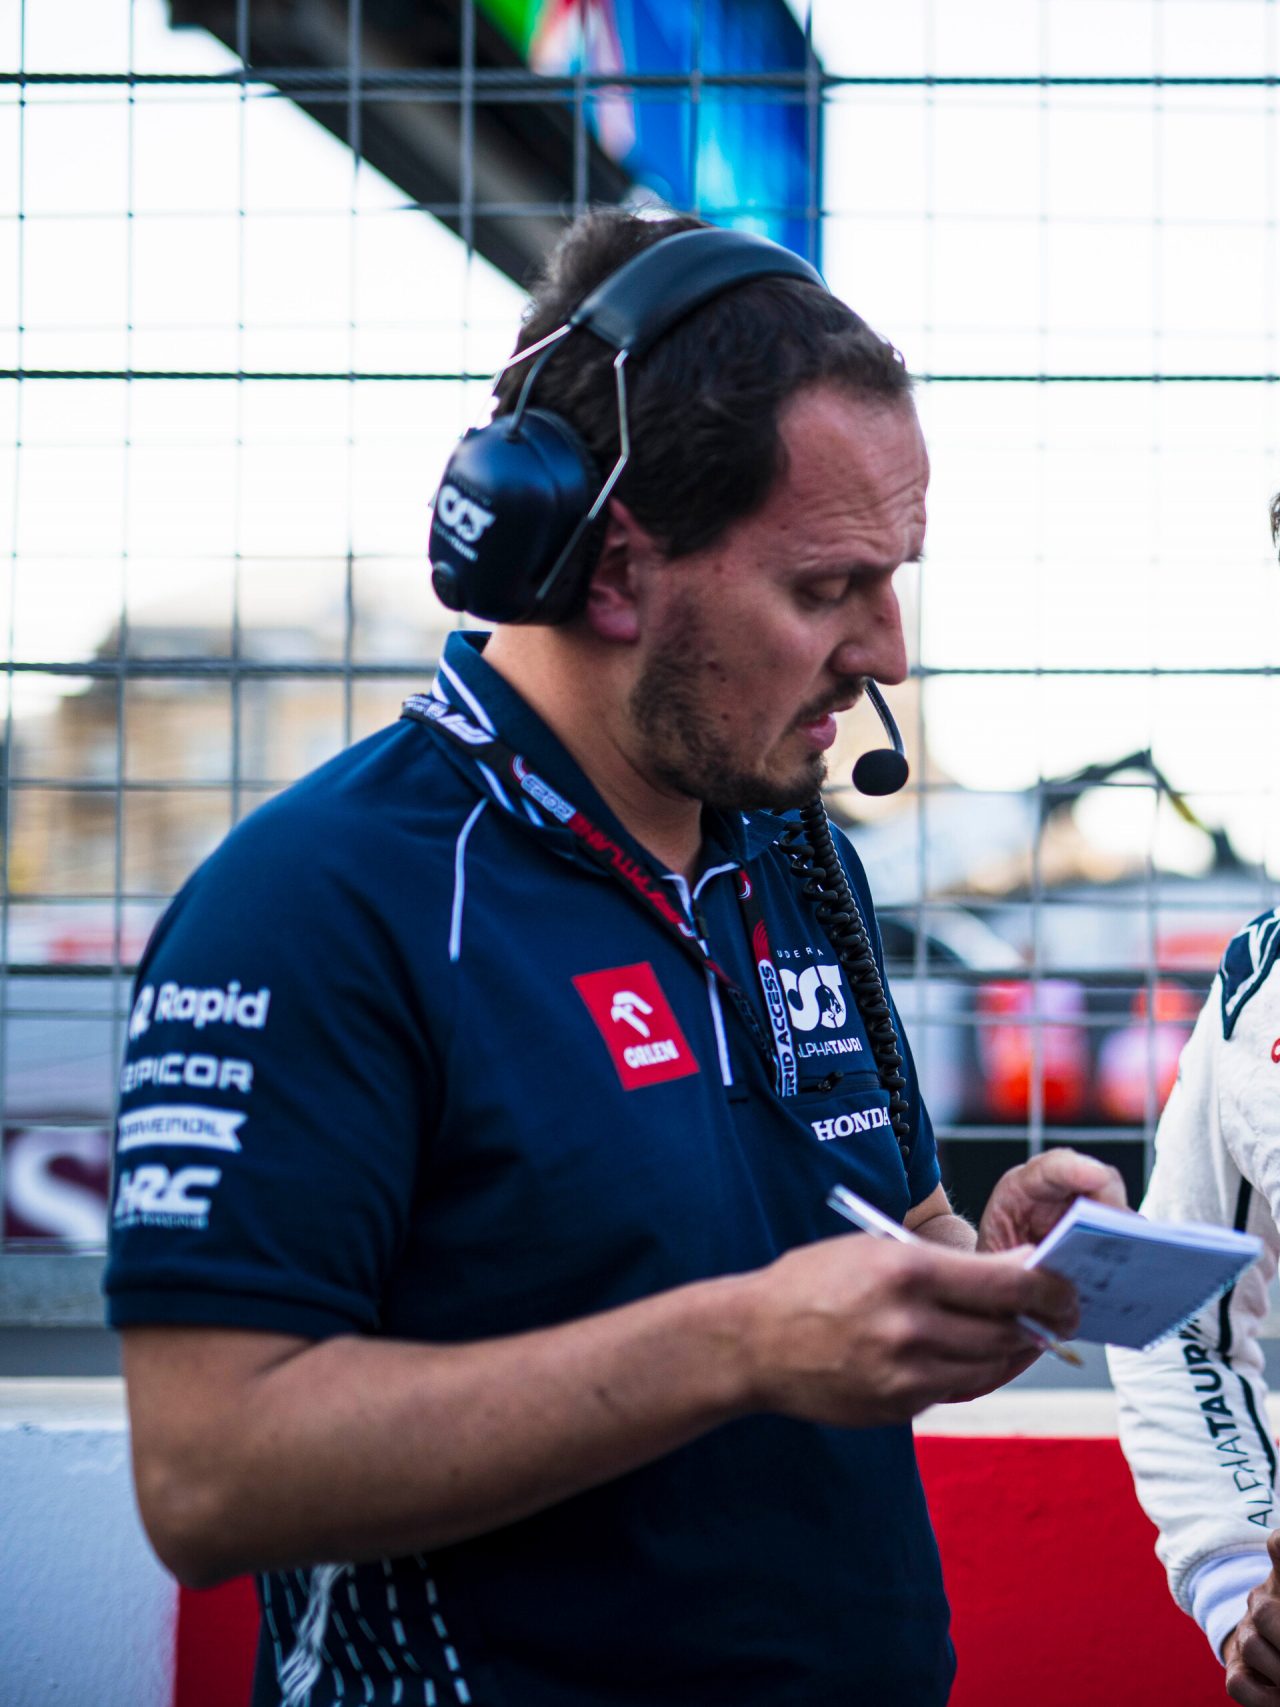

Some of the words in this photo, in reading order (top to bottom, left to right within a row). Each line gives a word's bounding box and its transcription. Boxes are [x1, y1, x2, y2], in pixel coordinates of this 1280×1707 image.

[154, 981, 271, 1030] Rapid
[760, 965, 791, 1047] ACCESS
[623, 1039, 680, 1069] ORLEN
[811, 1106, 891, 1141] HONDA
